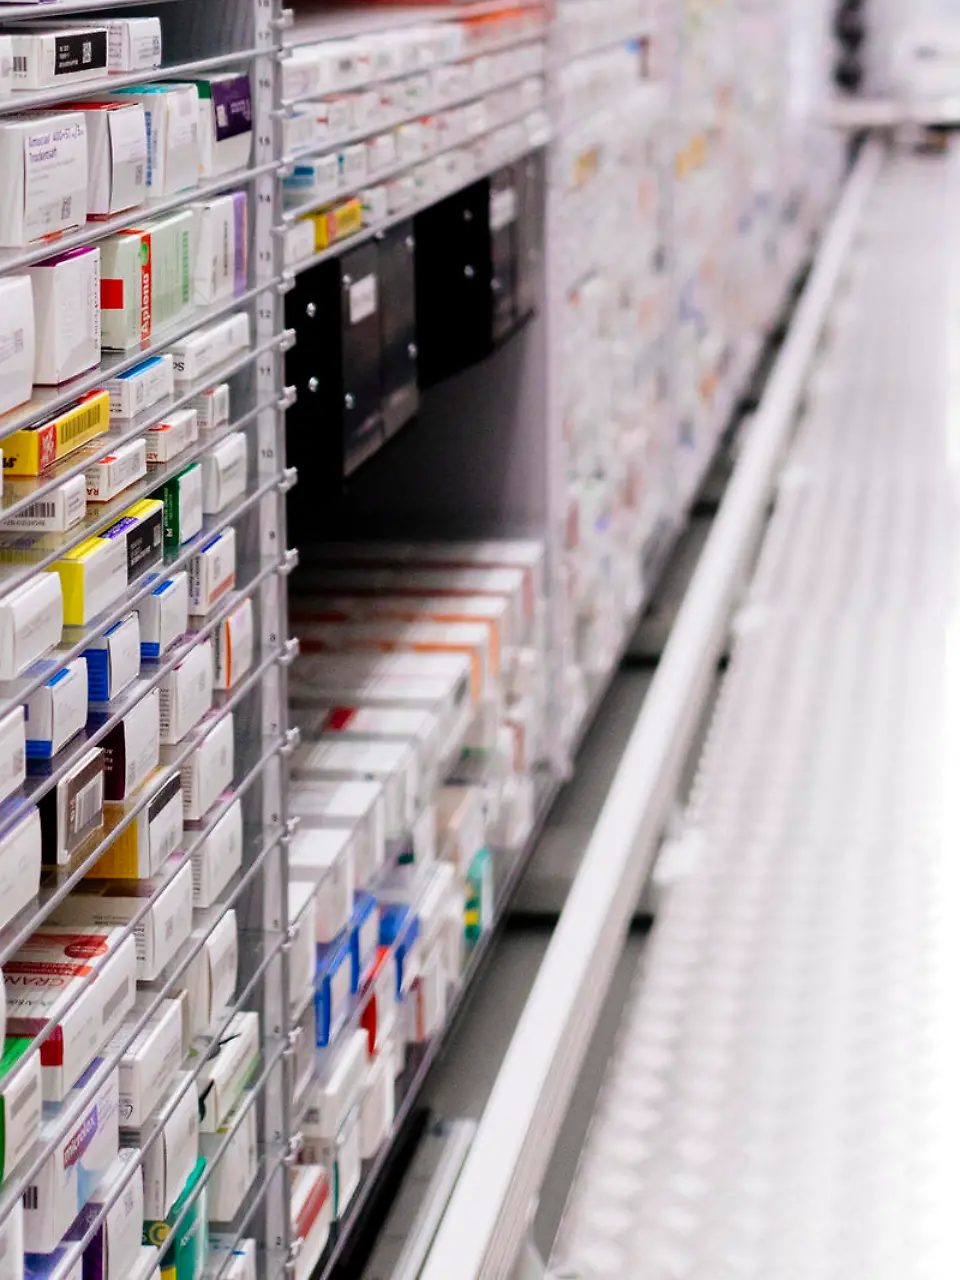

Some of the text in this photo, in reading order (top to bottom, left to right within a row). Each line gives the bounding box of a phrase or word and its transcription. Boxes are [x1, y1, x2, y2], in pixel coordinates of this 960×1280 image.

[258, 32, 270, 41] 17
[259, 137, 271, 146] 15
[259, 195, 271, 203] 14
[259, 252, 271, 261] 13
[140, 272, 150, 333] Aplona
[259, 310, 271, 319] 12
[260, 367, 271, 376] 11
[262, 450, 274, 458] 10
[4, 975, 69, 988] GRAN
